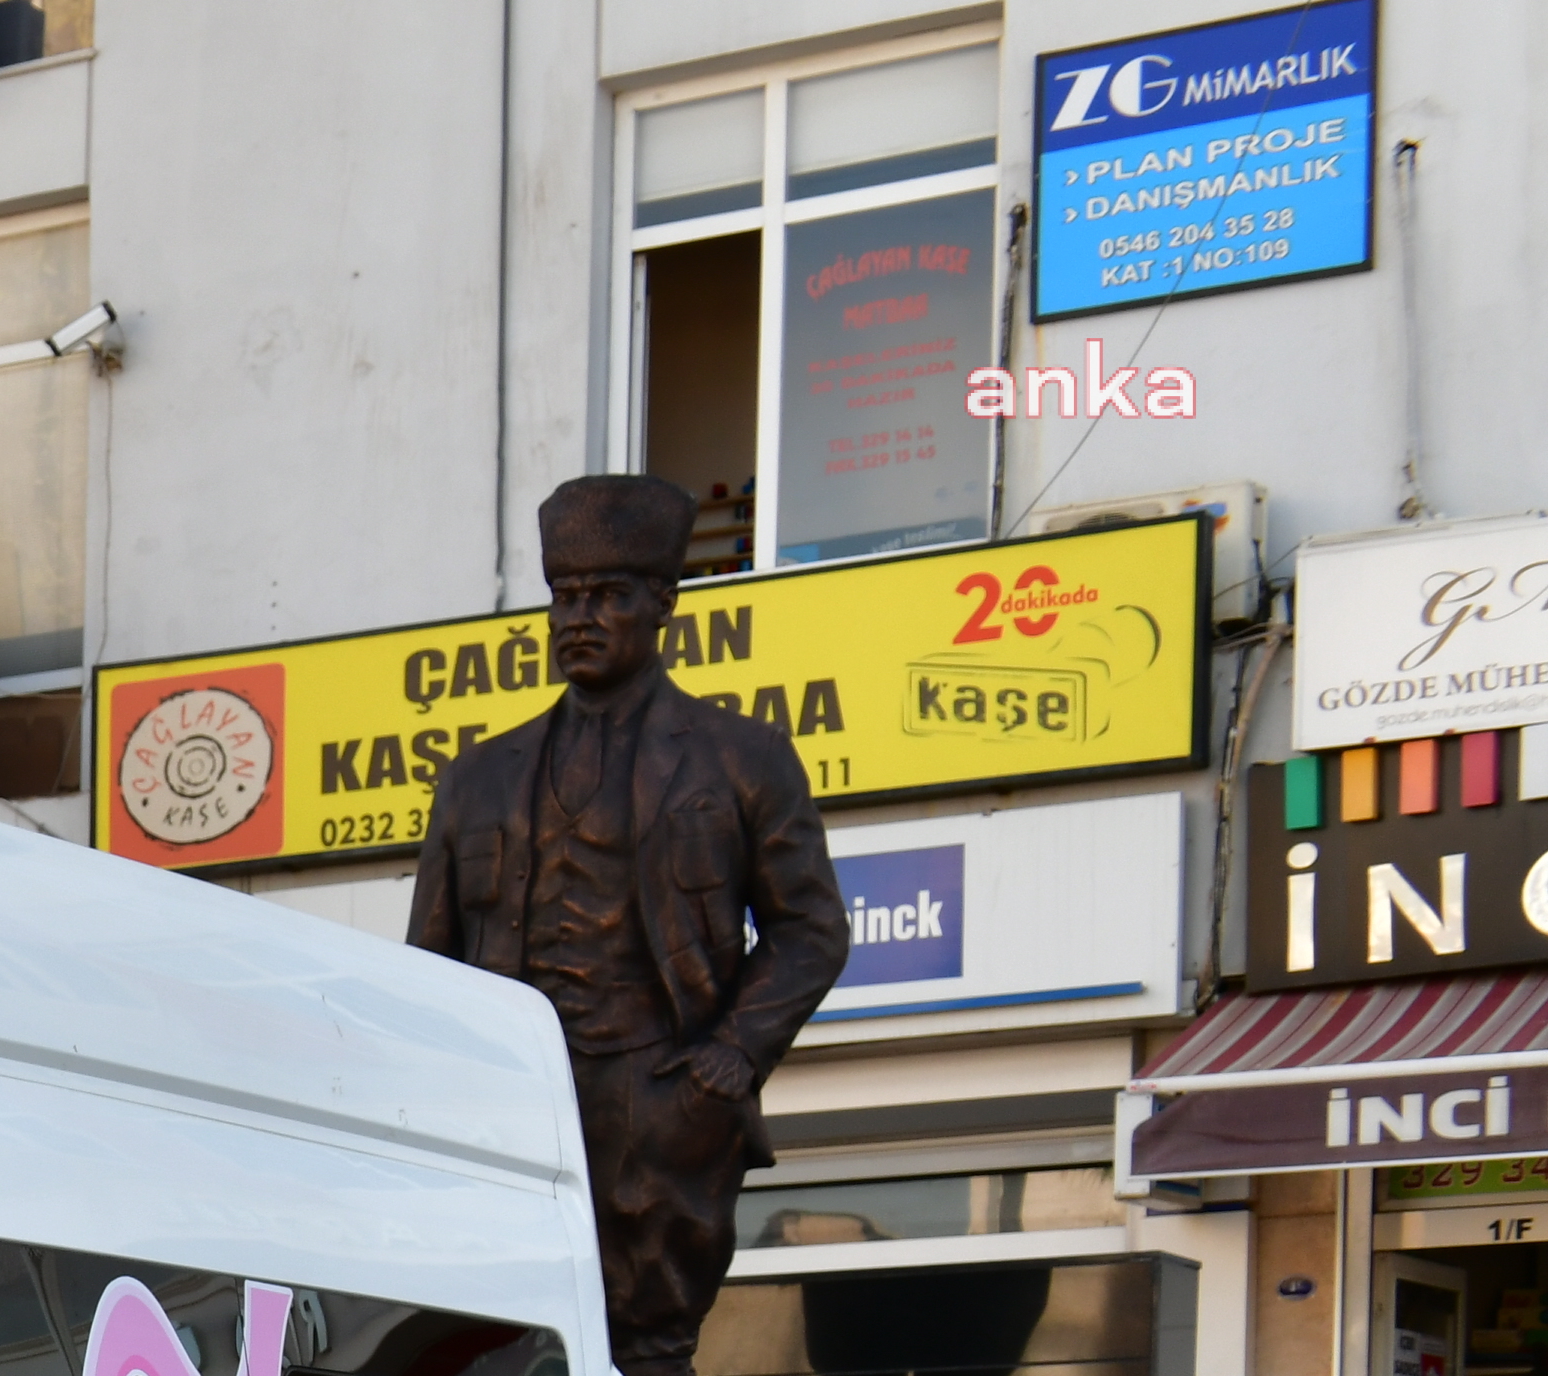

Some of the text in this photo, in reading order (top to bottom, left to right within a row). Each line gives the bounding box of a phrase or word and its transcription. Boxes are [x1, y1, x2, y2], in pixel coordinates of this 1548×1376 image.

[1050, 42, 1358, 131] ZG MİMARLIK
[1086, 118, 1347, 186] PLAN PROJE
[1085, 154, 1343, 222] DANIŞMANLIK
[1098, 208, 1294, 259] 0546 204 35 28
[1101, 260, 1155, 288] KAT
[1001, 584, 1099, 615] dakikada
[1318, 675, 1439, 712] GÖZDE
[320, 812, 396, 849] 0232
[1325, 1075, 1510, 1148] İNCİ
